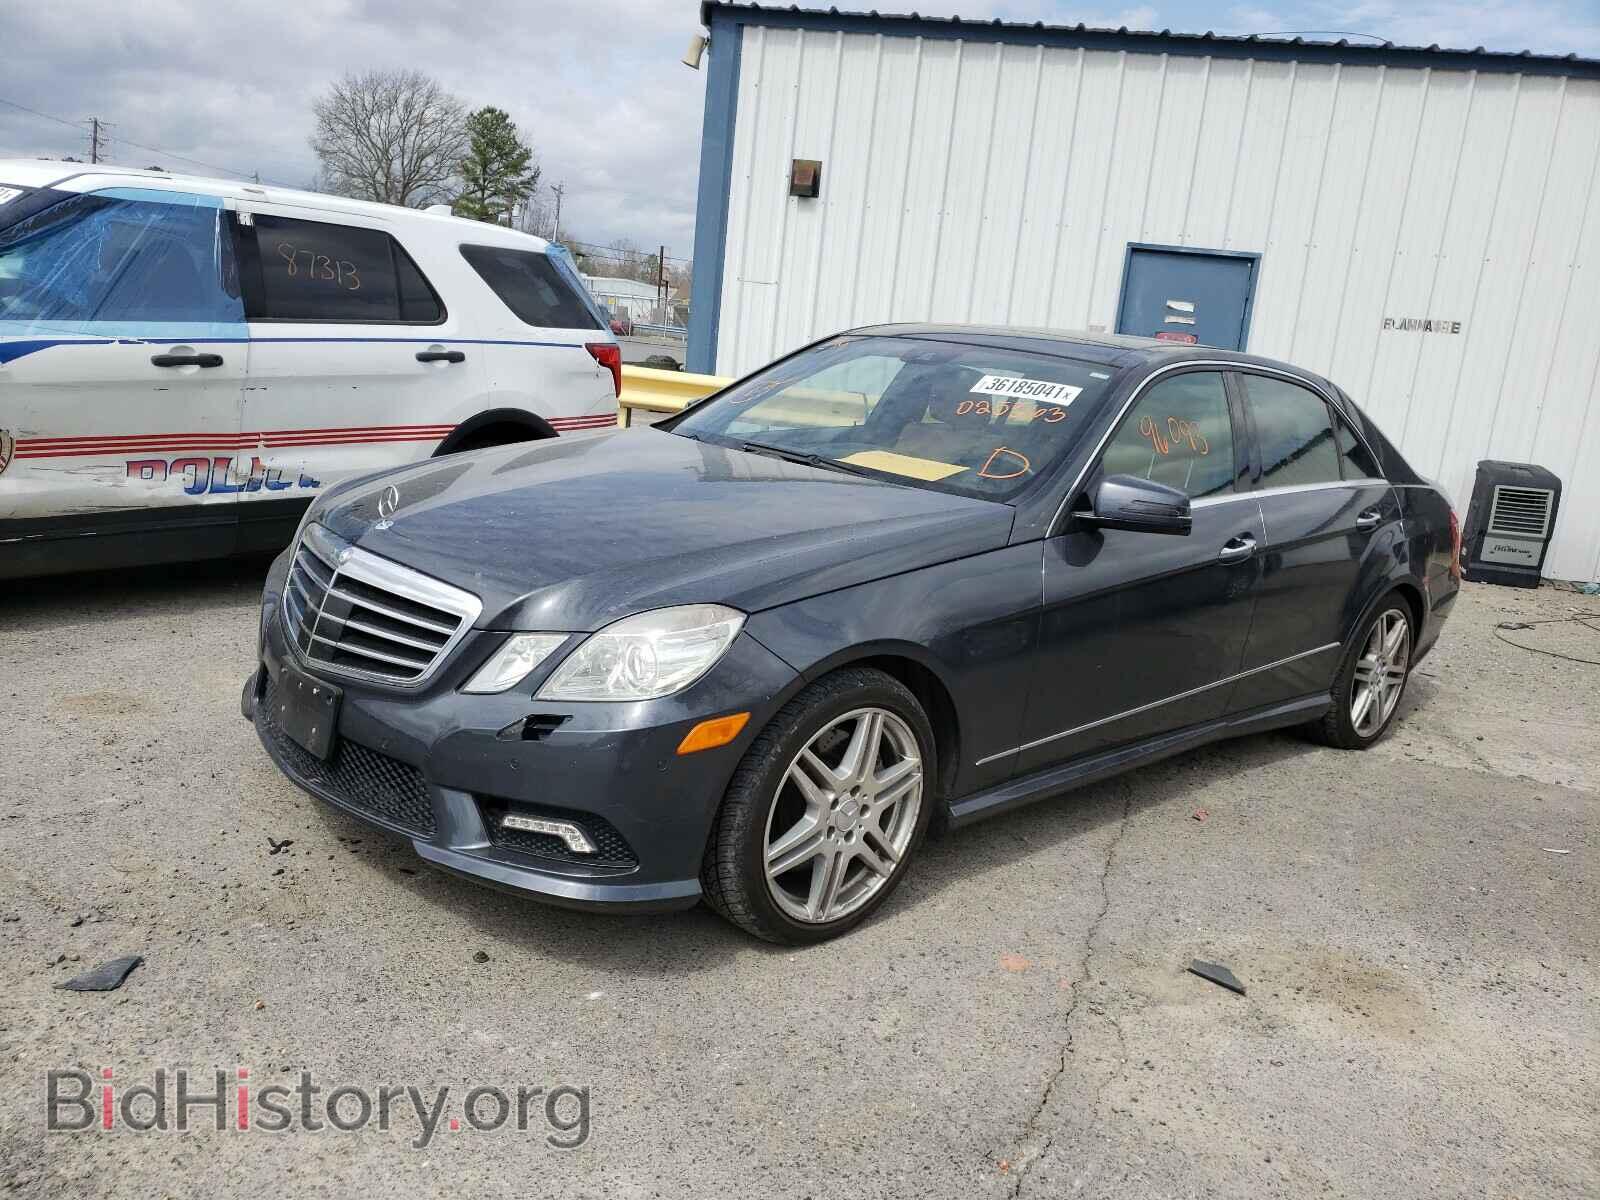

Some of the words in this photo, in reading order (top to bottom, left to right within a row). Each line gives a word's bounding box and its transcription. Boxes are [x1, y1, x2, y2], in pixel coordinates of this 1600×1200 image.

[278, 243, 361, 290] 87313
[1383, 318, 1461, 334] FLAMMAE
[977, 446, 1030, 479] D
